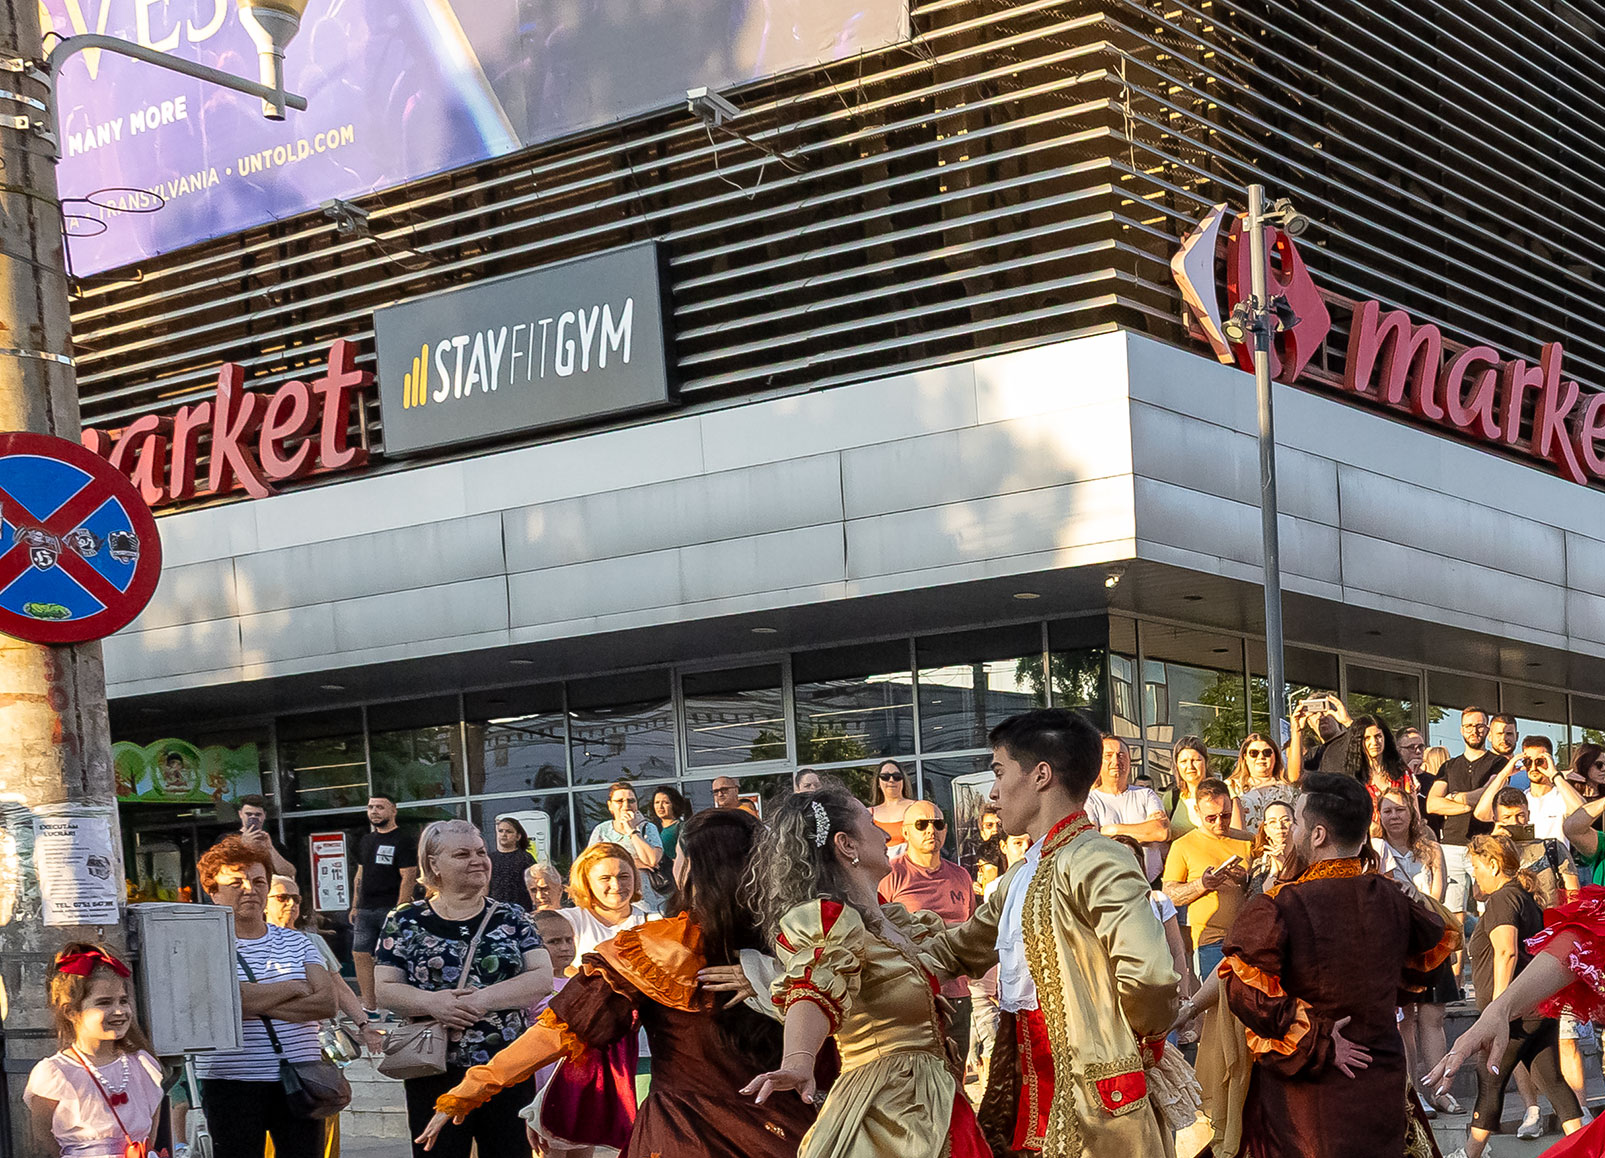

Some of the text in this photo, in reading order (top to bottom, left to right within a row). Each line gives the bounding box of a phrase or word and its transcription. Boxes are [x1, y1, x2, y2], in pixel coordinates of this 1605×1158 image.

[69, 96, 188, 157] MANY MORE
[99, 124, 355, 222] TRANSYLVANIA UNTOLD.COM
[81, 339, 367, 506] arket
